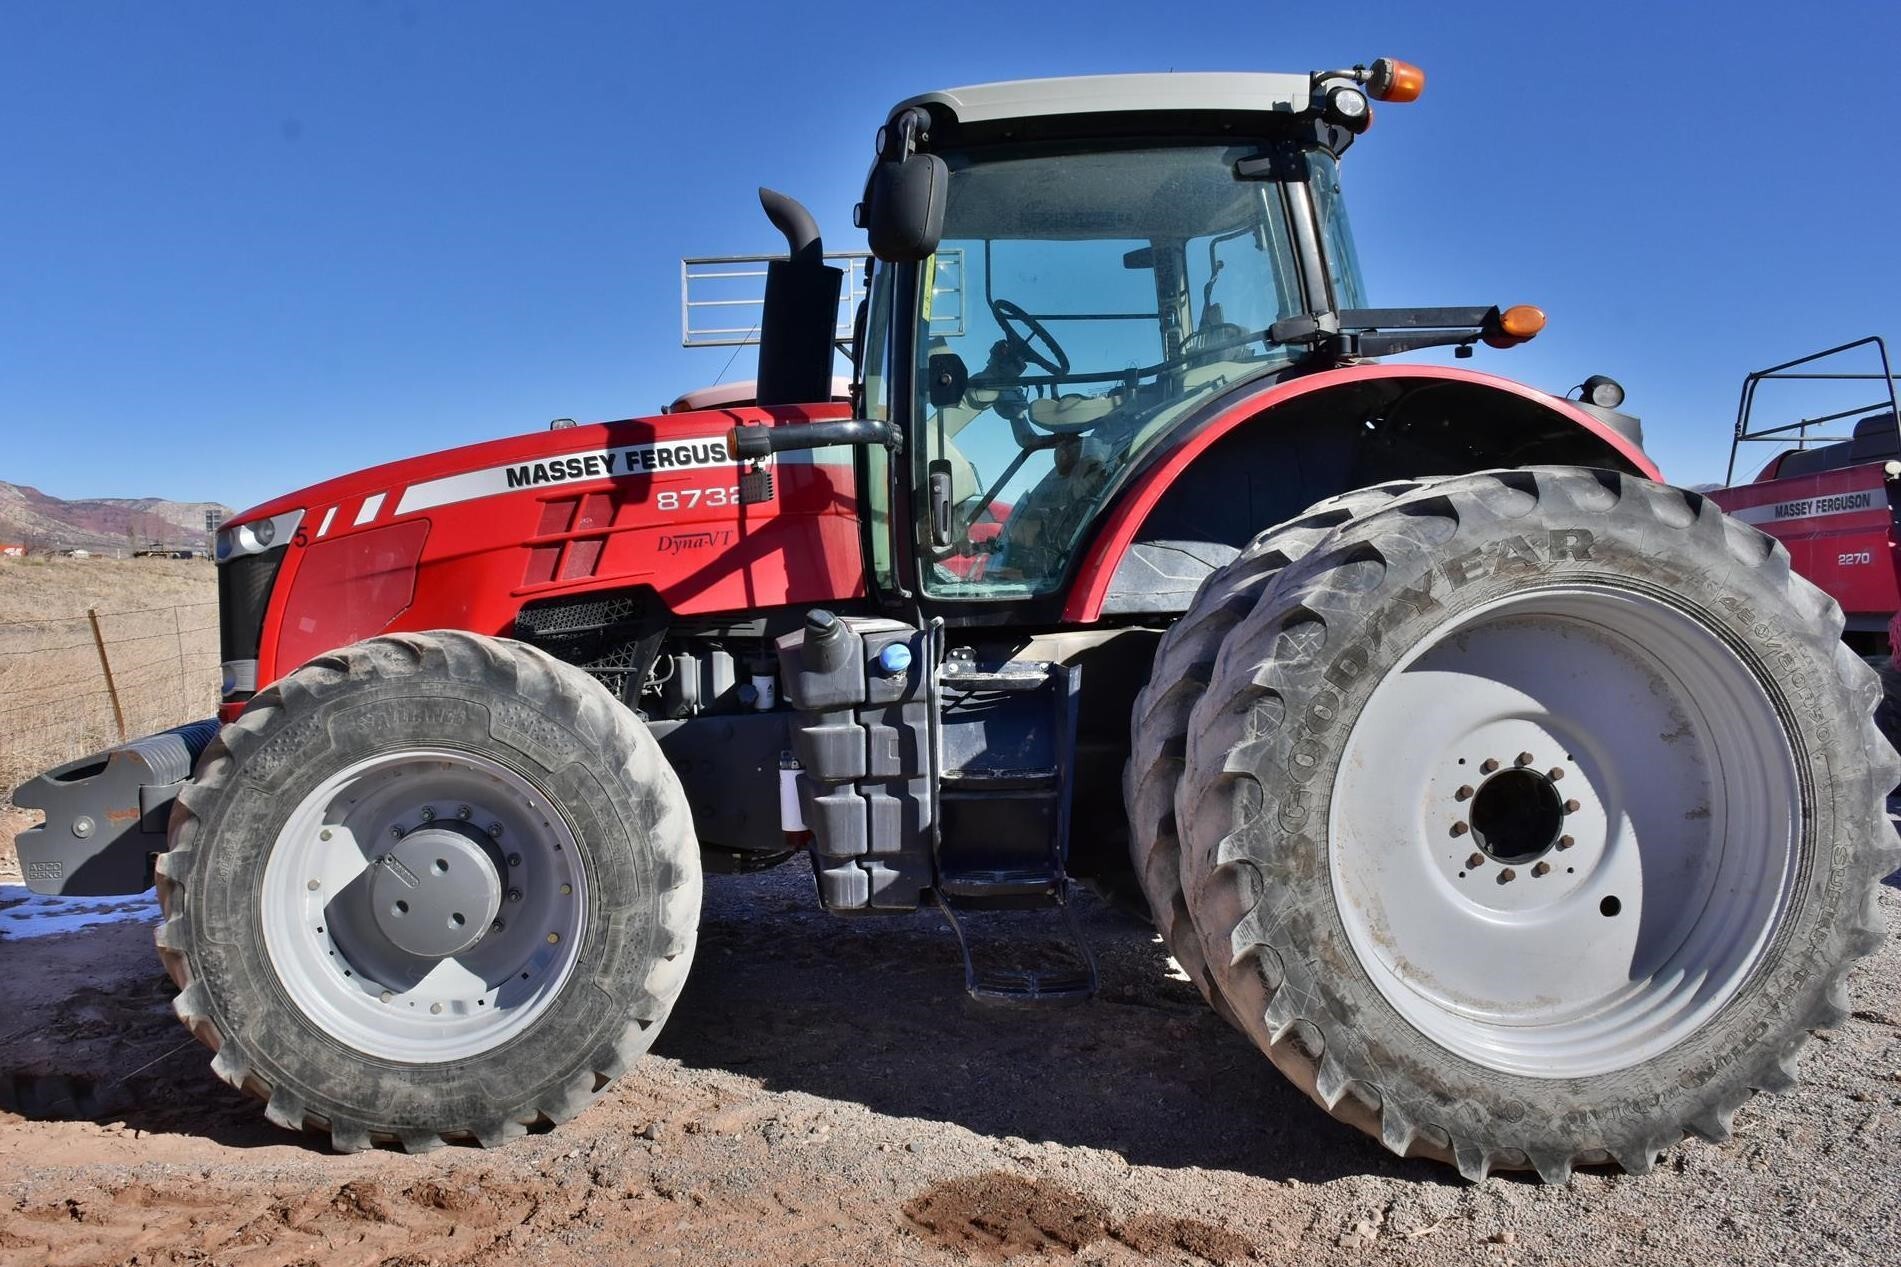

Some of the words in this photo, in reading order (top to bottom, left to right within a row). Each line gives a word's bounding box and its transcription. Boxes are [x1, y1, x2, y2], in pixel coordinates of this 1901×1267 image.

[506, 453, 617, 488] MASSEY
[625, 443, 728, 473] FERGUS
[1774, 501, 1813, 519] MASSEY
[1815, 492, 1872, 514] FERGUSON
[1837, 552, 1871, 566] 2270
[1277, 527, 1594, 834] GOODYEAR
